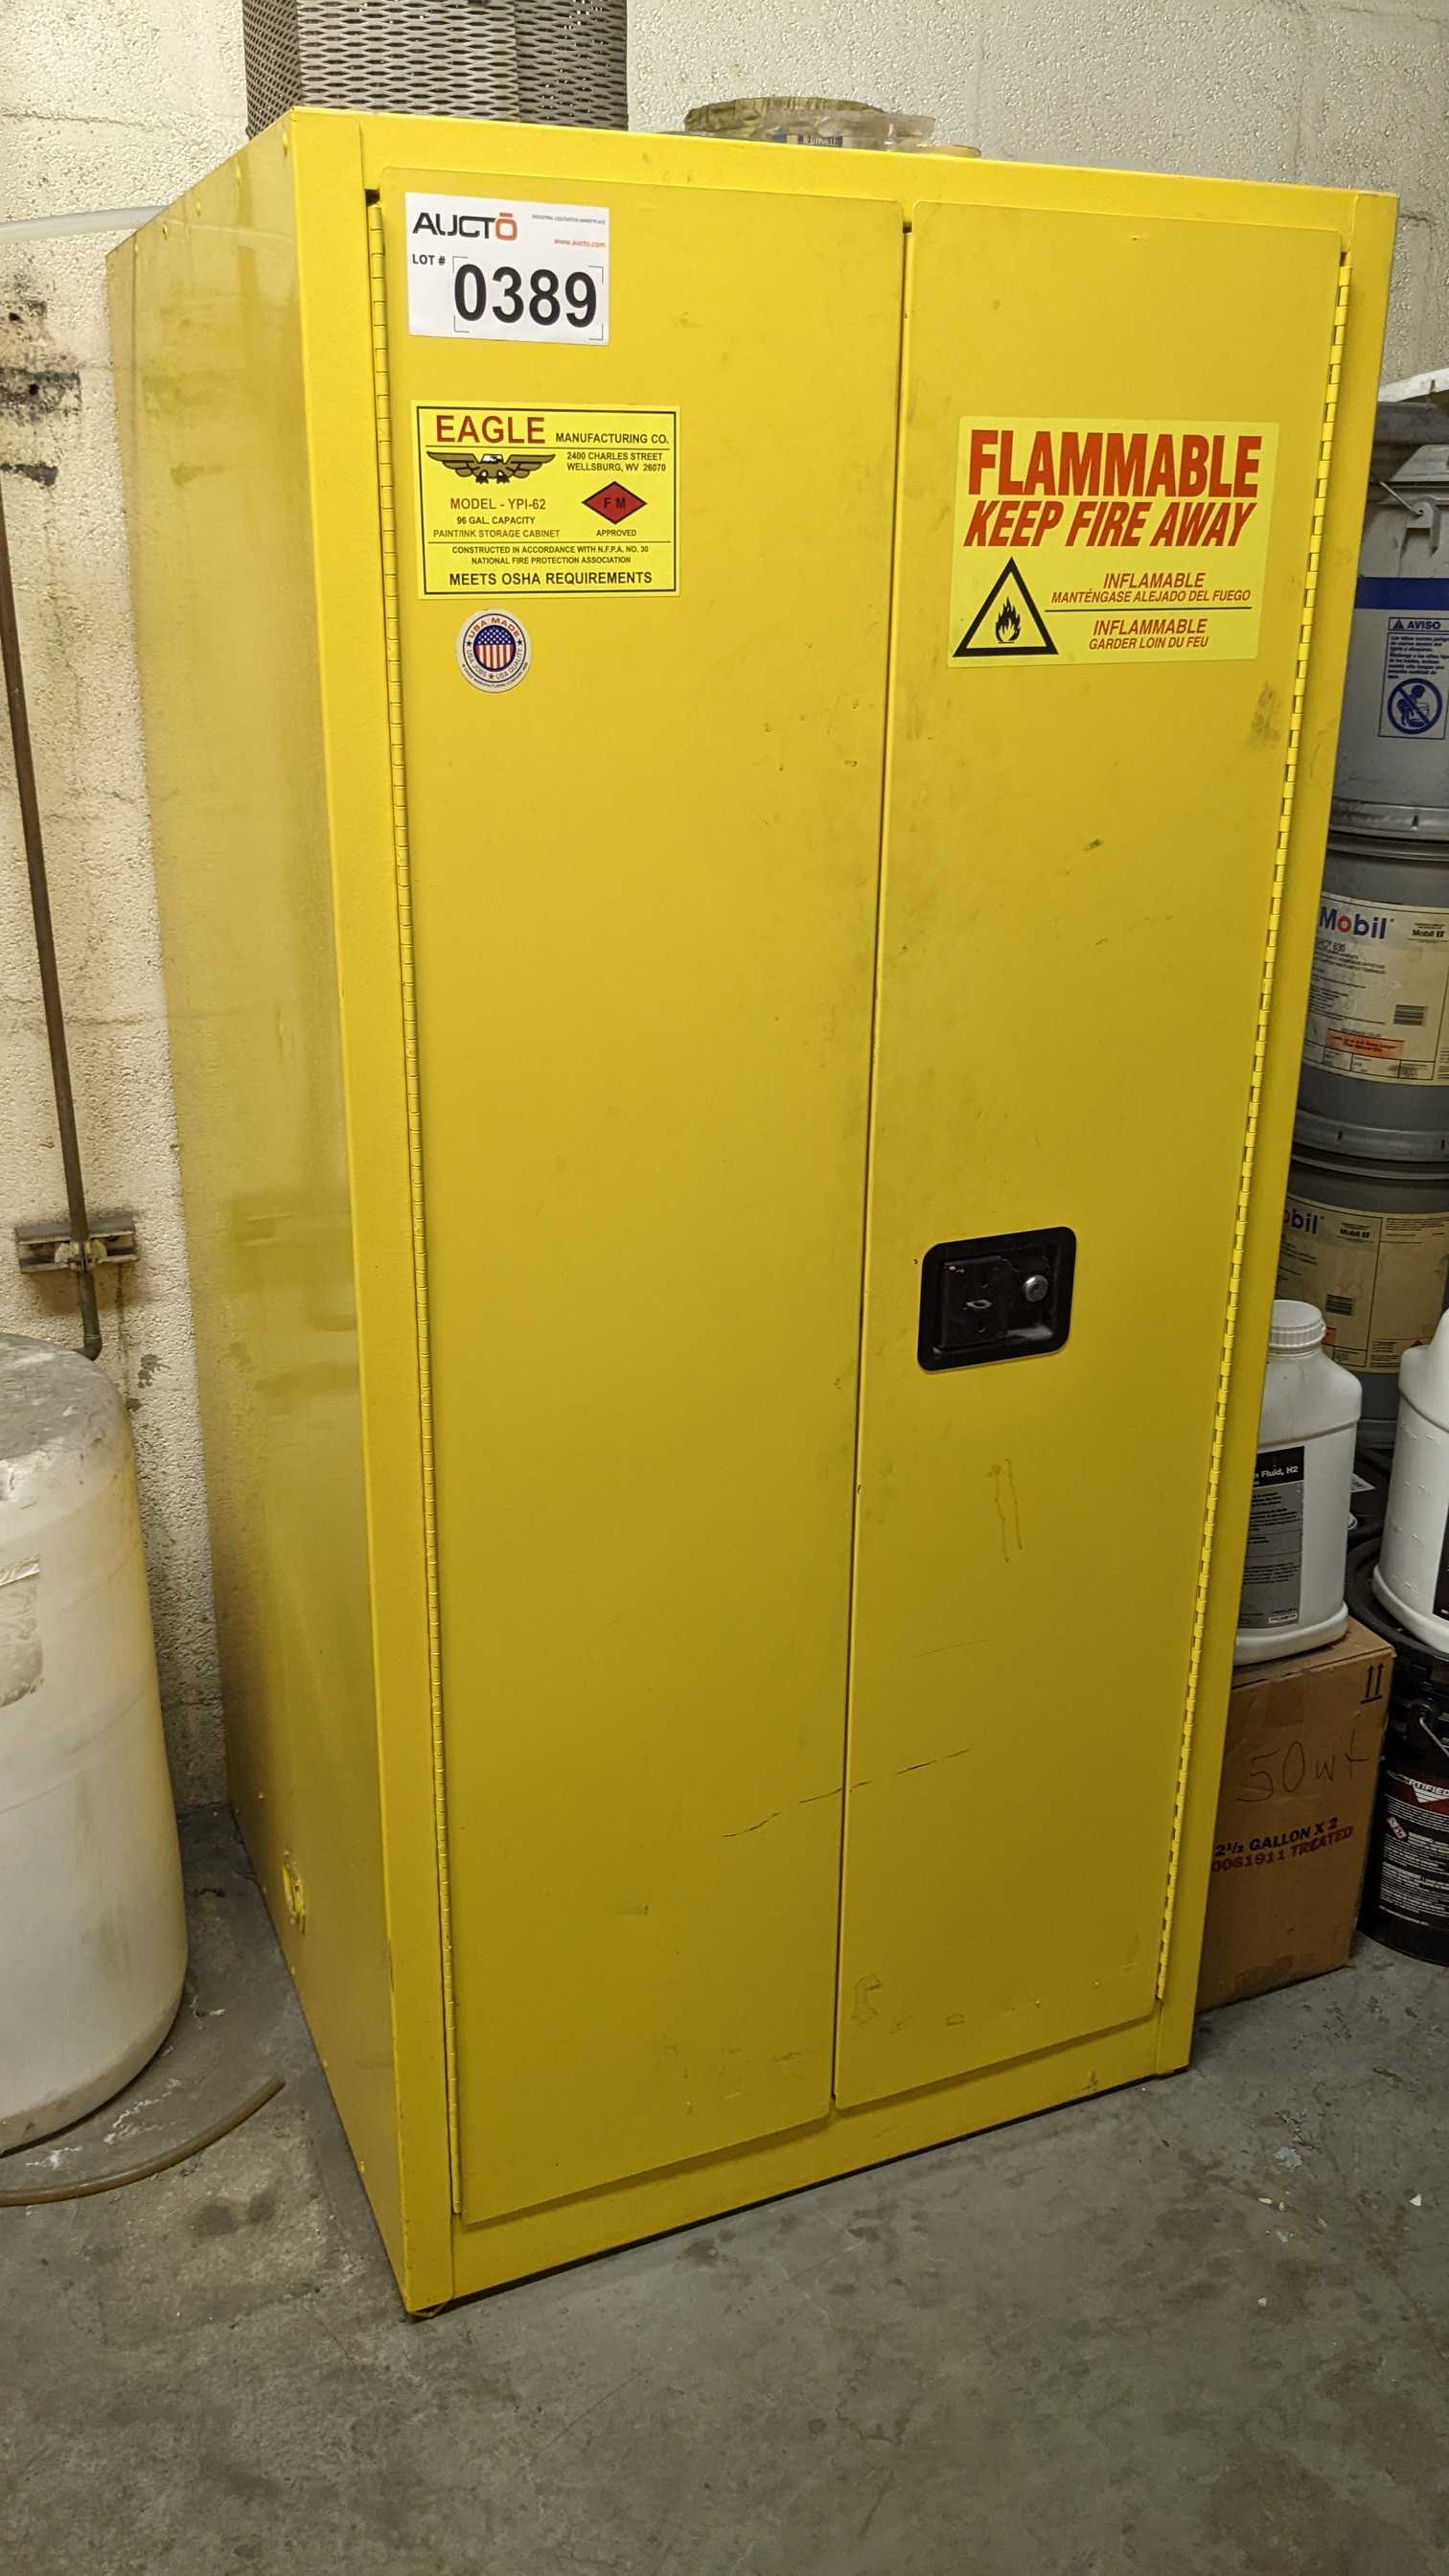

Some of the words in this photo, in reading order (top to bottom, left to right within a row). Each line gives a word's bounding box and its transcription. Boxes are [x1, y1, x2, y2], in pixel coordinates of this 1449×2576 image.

[412, 254, 435, 265] LOT
[438, 255, 447, 266] #
[454, 264, 597, 328] 0389
[436, 414, 546, 445] EAGLE
[556, 433, 648, 445] MANUFACTURING
[651, 434, 669, 445] CO.
[631, 452, 663, 461] STREET
[968, 429, 1263, 498] FLAMMABLE
[567, 463, 623, 472] WELLSBURG,
[450, 498, 495, 510] MODEL
[508, 498, 546, 510] YPI-62
[456, 516, 467, 525] 96
[469, 516, 490, 525] GAL.
[493, 516, 536, 525] CAPACITY
[963, 500, 1065, 547] KEEP
[1065, 501, 1153, 547] FIRE
[1149, 502, 1257, 547] AWAY
[433, 529, 476, 538] PAINT/INK
[479, 529, 519, 538] STORAGE
[522, 529, 560, 538] CABINET
[472, 557, 510, 565] NATIONAL
[449, 573, 496, 586] MEETS
[501, 573, 540, 586] OSHA
[545, 571, 653, 585] REQUIREMENTS
[1103, 573, 1206, 589] INFLAMABLE
[1050, 588, 1132, 604] MANTÉNGASE
[1133, 590, 1186, 603] ALEJADO
[1188, 590, 1209, 602] DEL
[1212, 590, 1251, 602] FUEGO
[491, 617, 520, 637] MADE
[1092, 618, 1208, 635] INFLAMMABLE
[1407, 621, 1441, 631] AVISO
[1089, 638, 1137, 650] GARDER
[1138, 637, 1166, 650] LOIN
[1168, 637, 1184, 650] DU
[1186, 636, 1208, 648] FEU
[1319, 907, 1388, 939] Mobil
[1249, 1827, 1311, 1852] GALLON
[1314, 1821, 1328, 1836] X
[1290, 1826, 1353, 1857] TREATED
